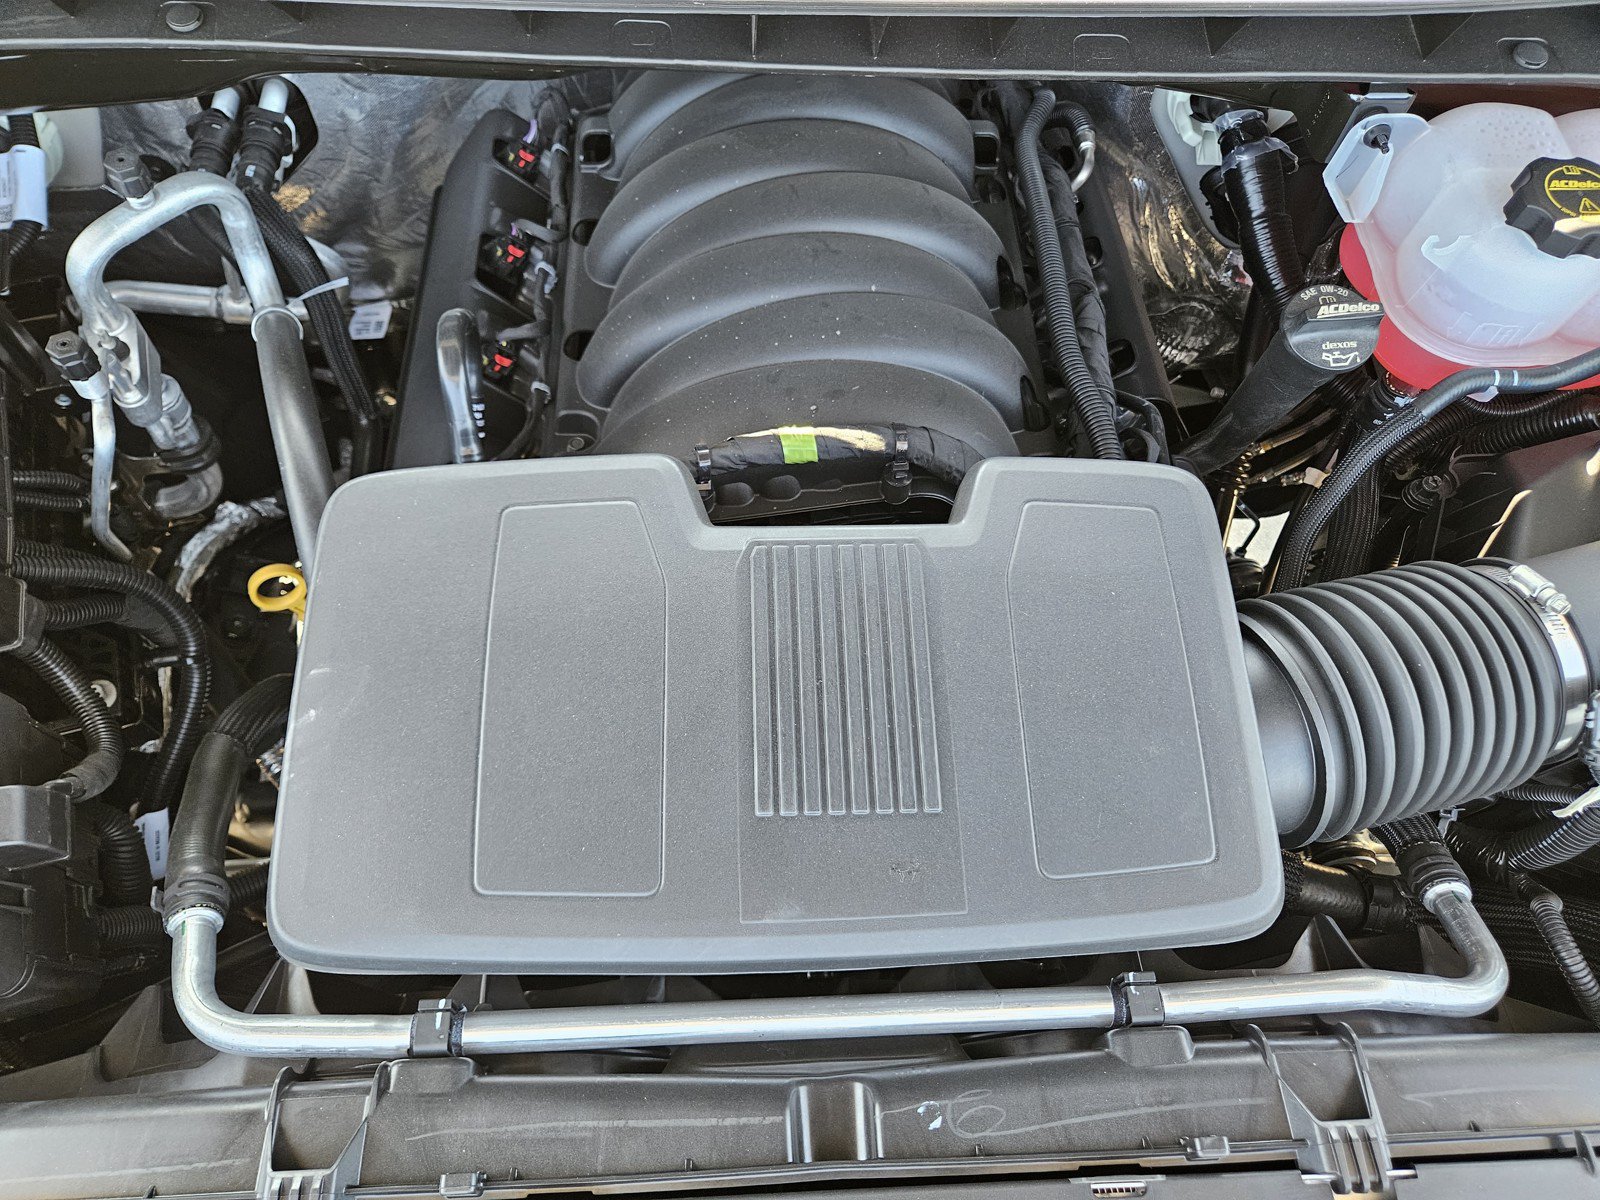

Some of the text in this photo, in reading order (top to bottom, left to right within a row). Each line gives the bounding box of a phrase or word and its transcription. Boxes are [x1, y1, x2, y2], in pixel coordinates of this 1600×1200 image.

[1549, 180, 1600, 188] ACDelc
[1300, 285, 1349, 301] SAE 0W-20
[1317, 302, 1380, 316] ACDelco
[1322, 341, 1358, 350] dexos
